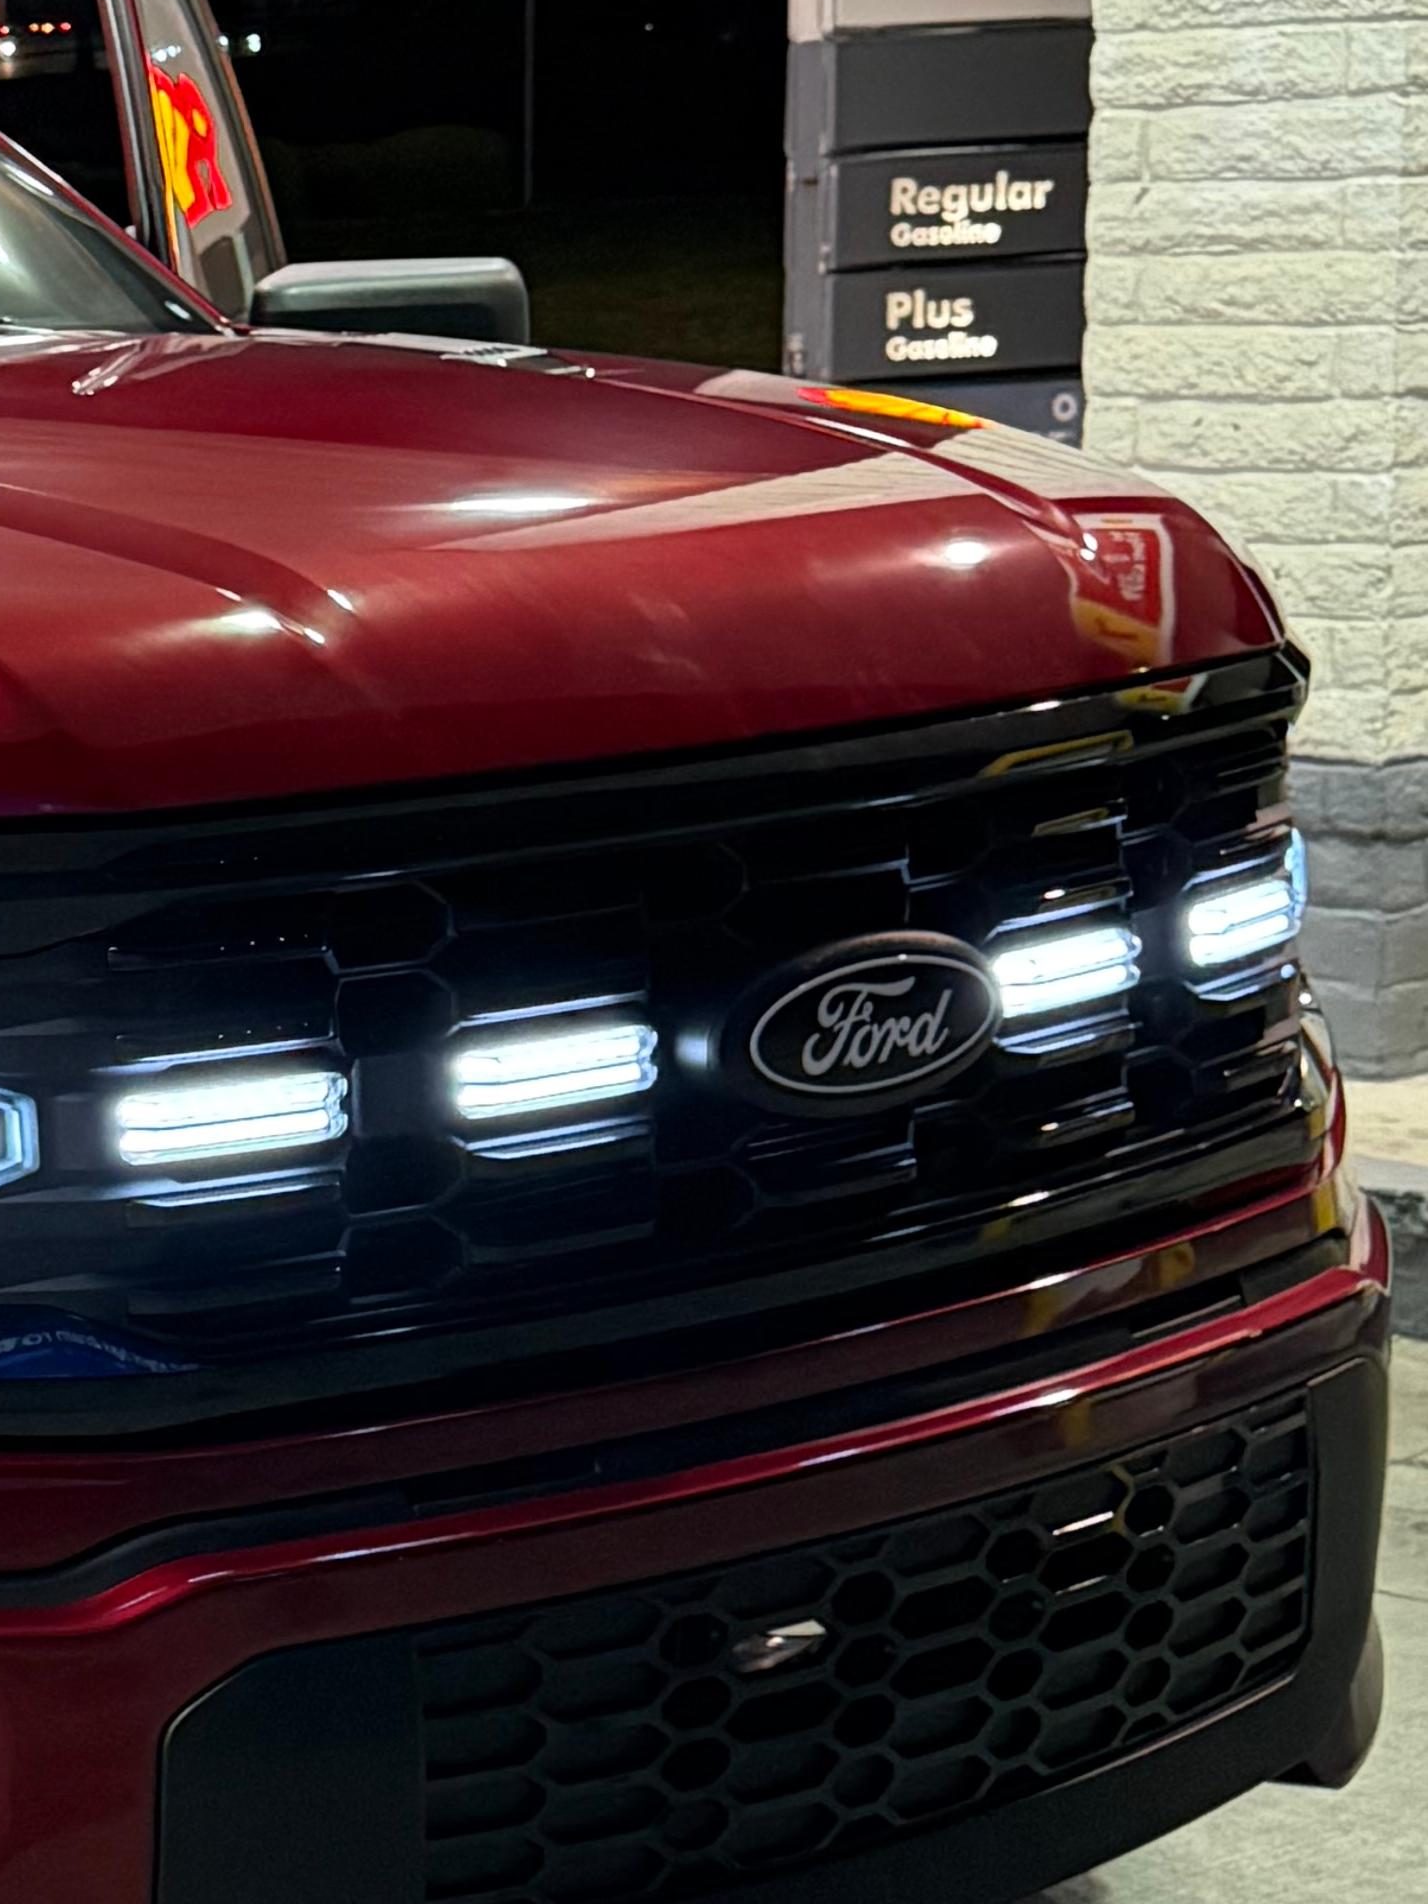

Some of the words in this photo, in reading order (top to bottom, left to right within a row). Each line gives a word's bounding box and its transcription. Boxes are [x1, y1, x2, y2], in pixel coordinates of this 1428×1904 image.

[890, 170, 1055, 222] Regular
[890, 220, 1002, 247] Gasoline
[886, 289, 974, 331] Plus
[886, 331, 998, 362] Gasoline
[802, 976, 952, 1076] Ford
